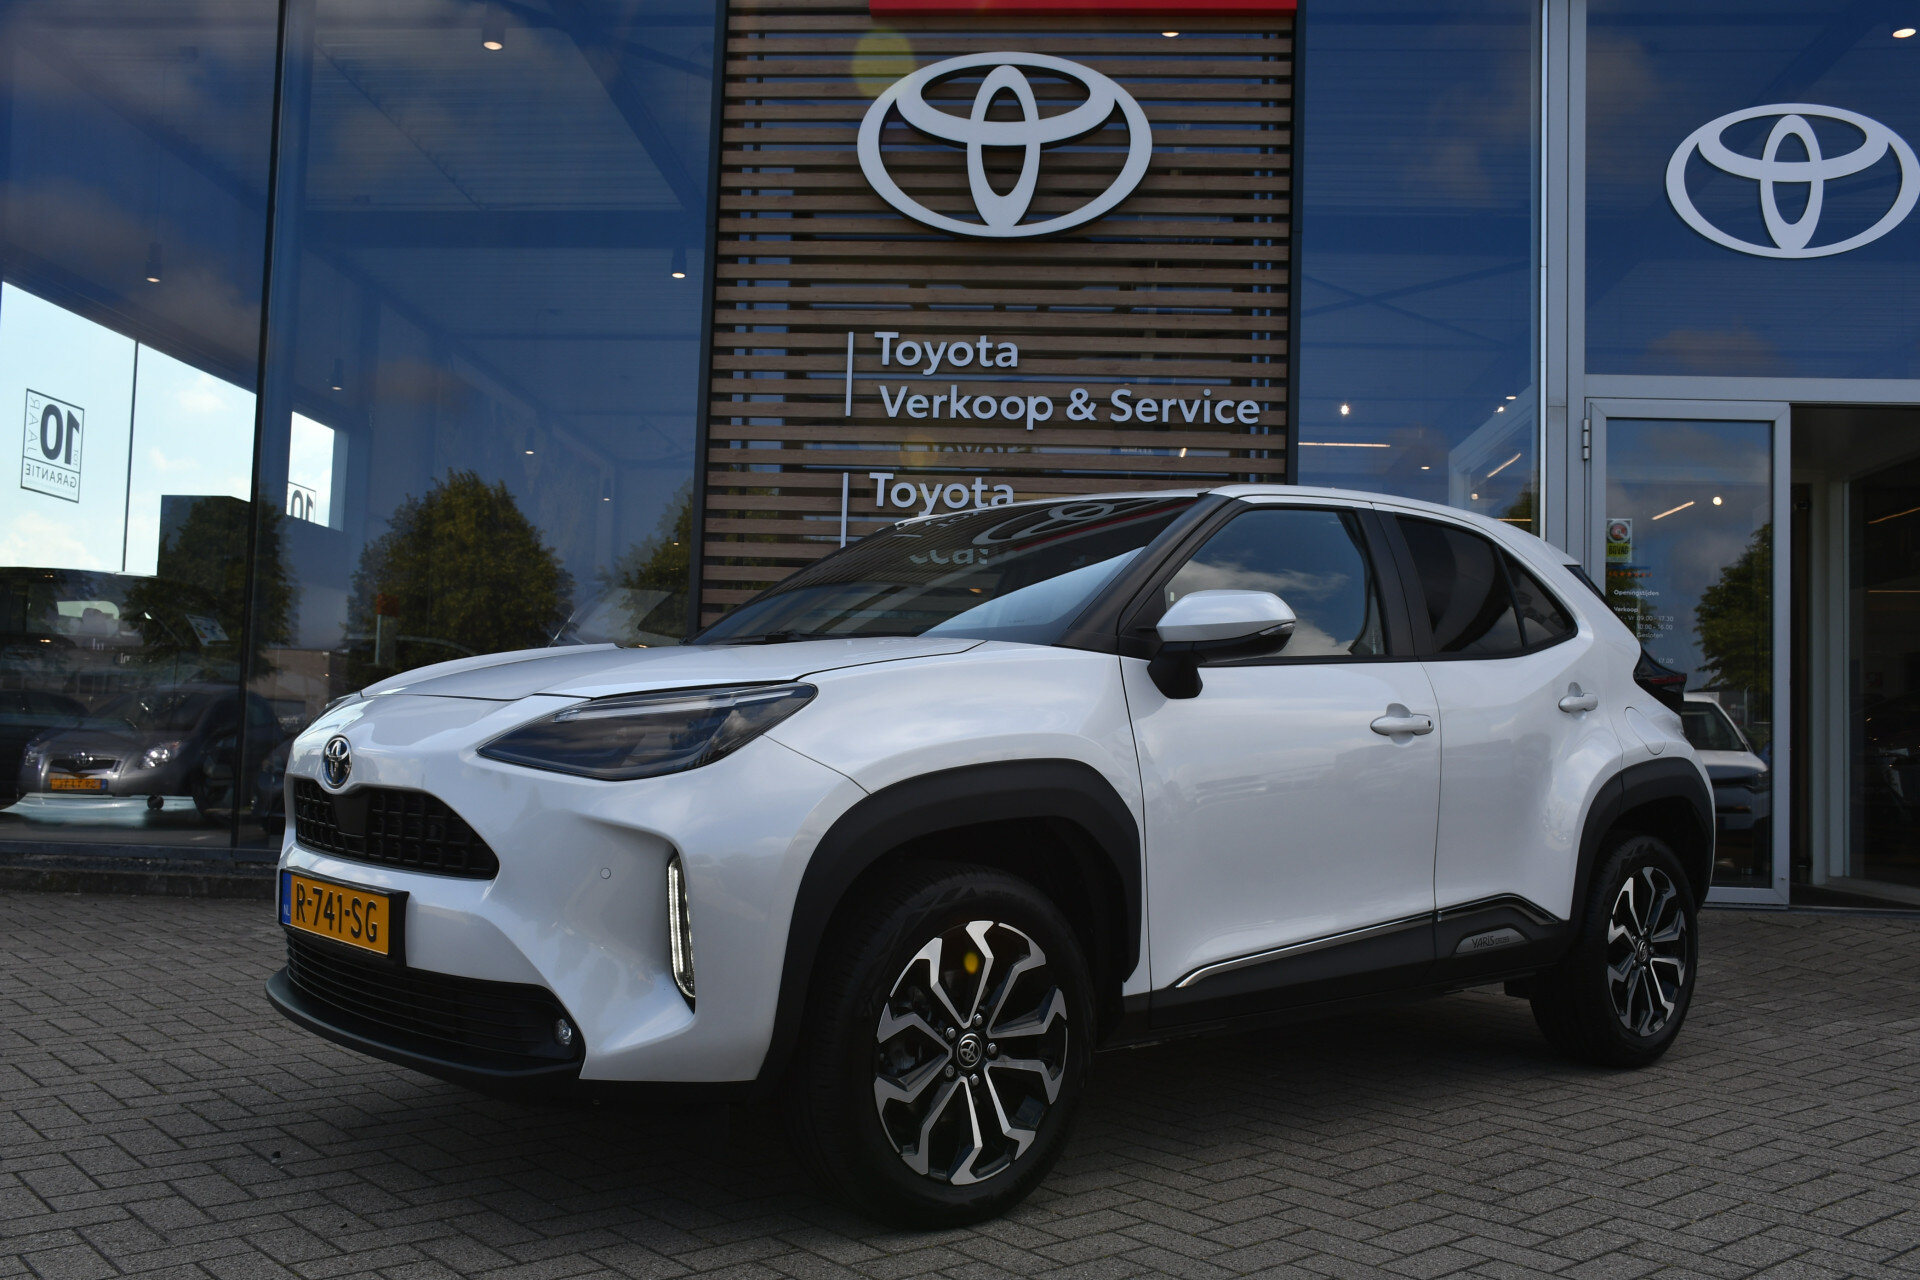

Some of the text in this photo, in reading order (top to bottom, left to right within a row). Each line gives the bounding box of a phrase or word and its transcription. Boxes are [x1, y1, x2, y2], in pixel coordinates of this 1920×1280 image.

[874, 331, 1019, 376] Toyota
[878, 384, 1261, 431] Verkoop & Service
[869, 472, 1014, 517] Toyota
[1613, 589, 1659, 597] Openingstijden
[283, 903, 291, 916] NL
[296, 881, 378, 943] R-741-SG
[1471, 935, 1495, 948] YARIS
